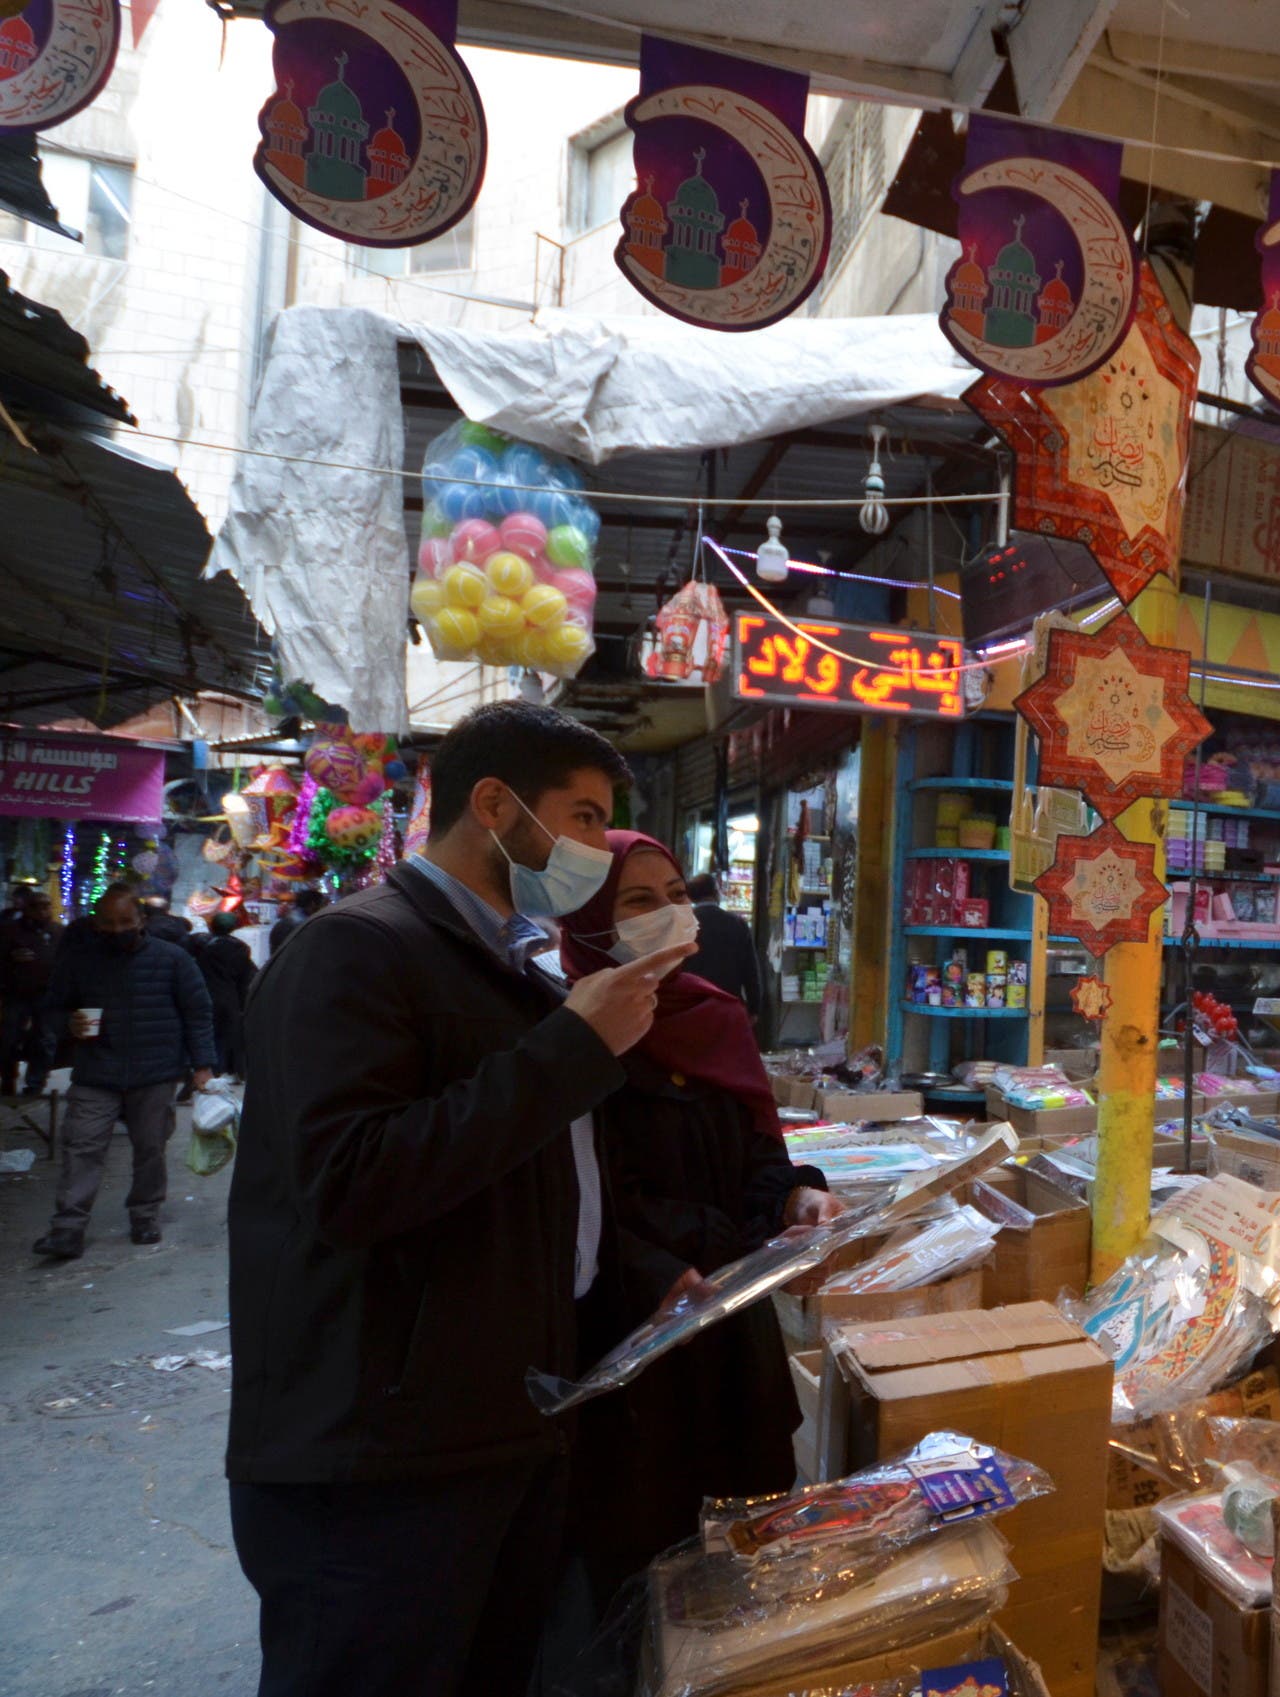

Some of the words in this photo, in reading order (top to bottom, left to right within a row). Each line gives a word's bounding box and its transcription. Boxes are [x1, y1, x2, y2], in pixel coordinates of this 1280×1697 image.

[1094, 415, 1143, 466] رمضان
[1087, 446, 1142, 487] كريم
[748, 635, 841, 693] ولاد
[1092, 709, 1131, 740] رمضان
[32, 744, 118, 774] مؤسسة
[13, 772, 96, 795] HILLS
